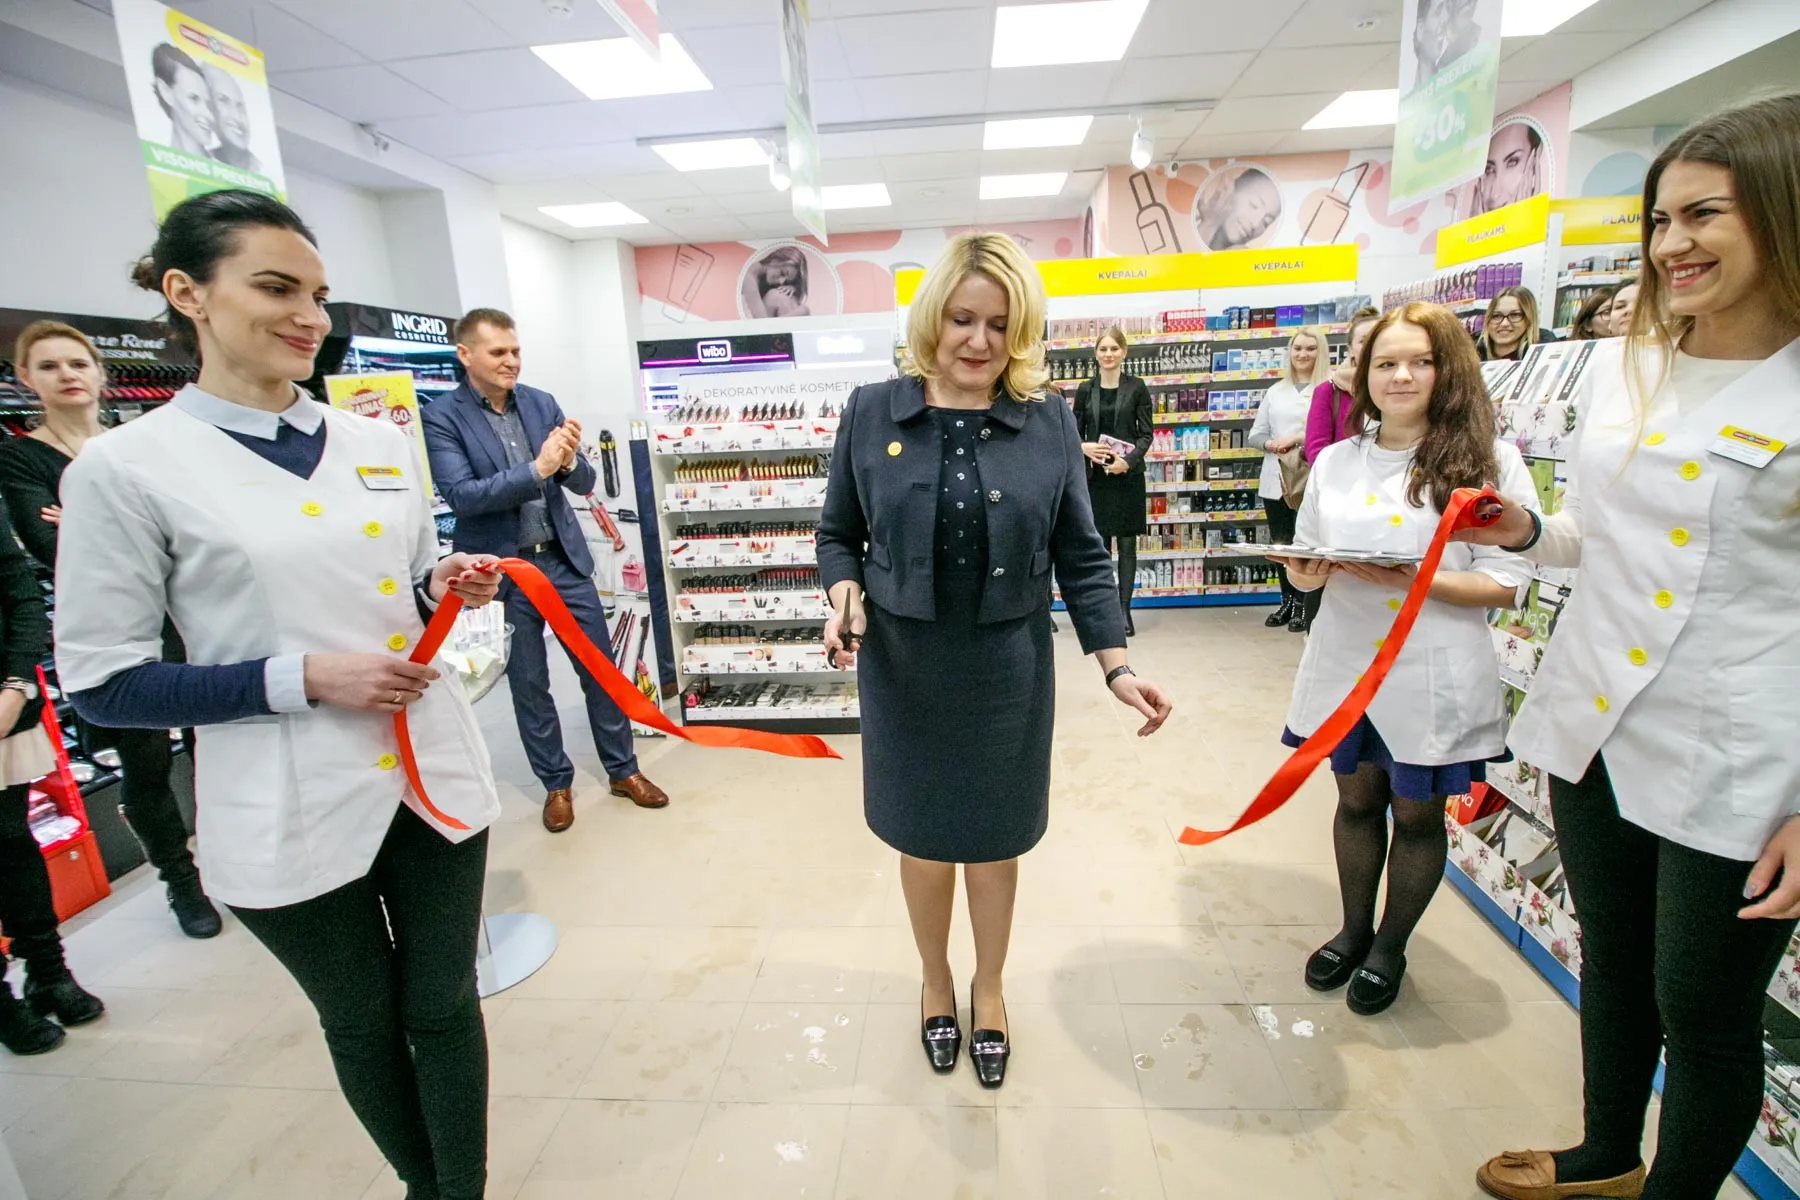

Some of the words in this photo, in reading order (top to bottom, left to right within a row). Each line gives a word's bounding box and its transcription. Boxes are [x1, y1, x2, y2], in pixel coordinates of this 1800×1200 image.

[1466, 224, 1505, 244] PLAUKAMS
[1254, 261, 1304, 271] KVEPALAI
[1098, 269, 1147, 280] KVEPALAI
[391, 312, 447, 336] INGRID
[394, 330, 448, 344] COSMETICS
[702, 344, 726, 358] wibo
[703, 381, 797, 399] DEKORATYVINĖ
[800, 379, 867, 394] KOSMETIK
